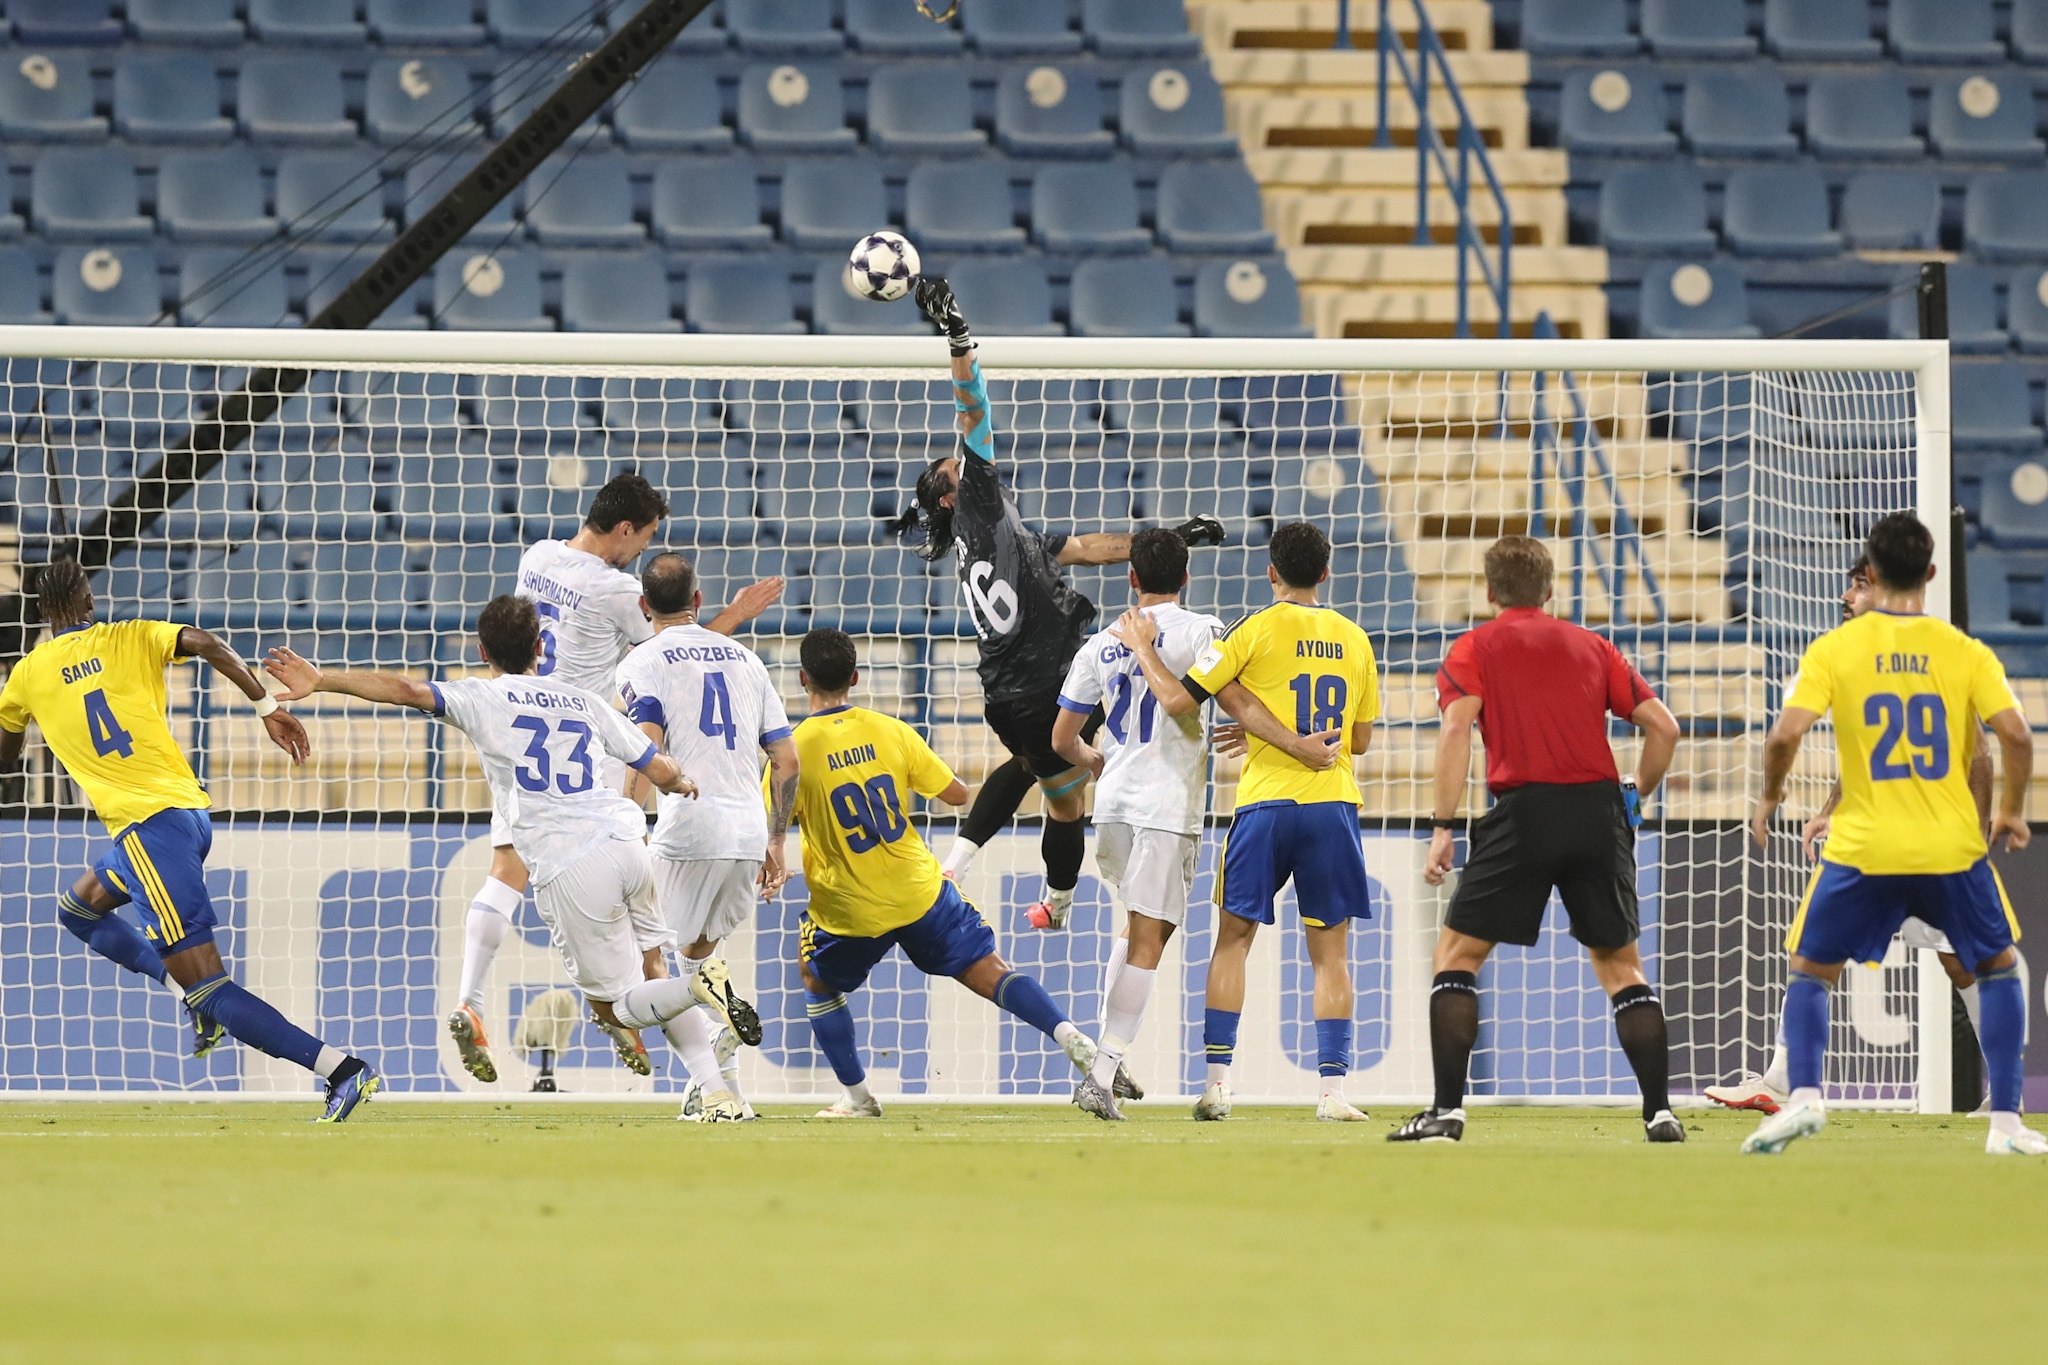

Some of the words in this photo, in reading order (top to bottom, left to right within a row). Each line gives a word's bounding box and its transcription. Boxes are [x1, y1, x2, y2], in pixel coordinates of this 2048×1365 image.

[523, 569, 582, 610] ASHURMATOV
[662, 646, 748, 665] ROOZBEH
[1296, 640, 1343, 660] AYOUB
[1875, 652, 1929, 674] F.DIAZ
[61, 657, 103, 685] SANO
[507, 691, 590, 713] A.AGHASI
[698, 671, 736, 750] 4
[1289, 673, 1347, 747] 18
[83, 688, 134, 759] 4
[1864, 692, 1949, 781] 29
[510, 714, 594, 795] 33
[827, 743, 876, 771] ALADIN
[830, 773, 907, 854] 90
